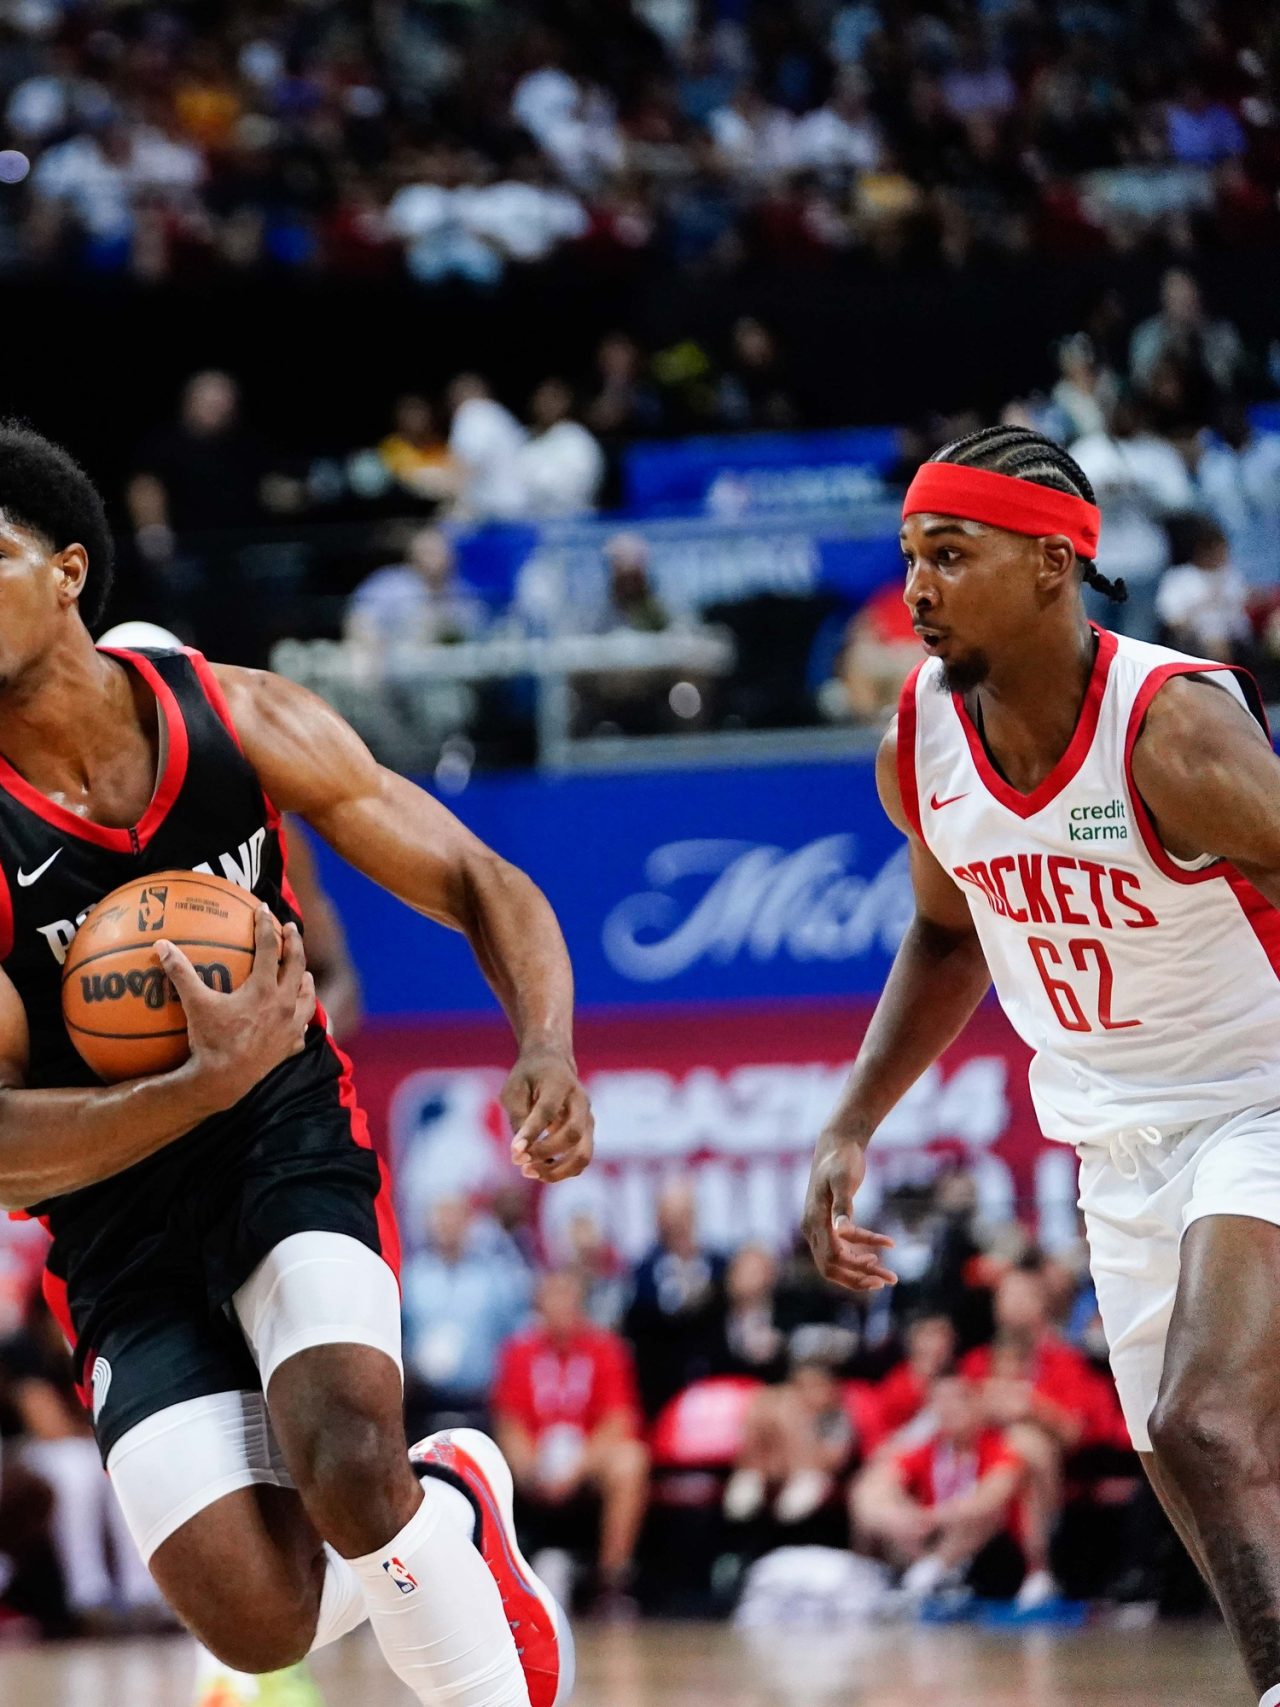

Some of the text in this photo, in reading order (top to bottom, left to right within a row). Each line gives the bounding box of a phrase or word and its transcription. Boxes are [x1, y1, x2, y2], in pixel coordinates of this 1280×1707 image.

[1070, 799, 1126, 821] credit
[1068, 822, 1128, 841] karma
[81, 962, 233, 1009] Wlson
[1027, 935, 1144, 1032] 62
